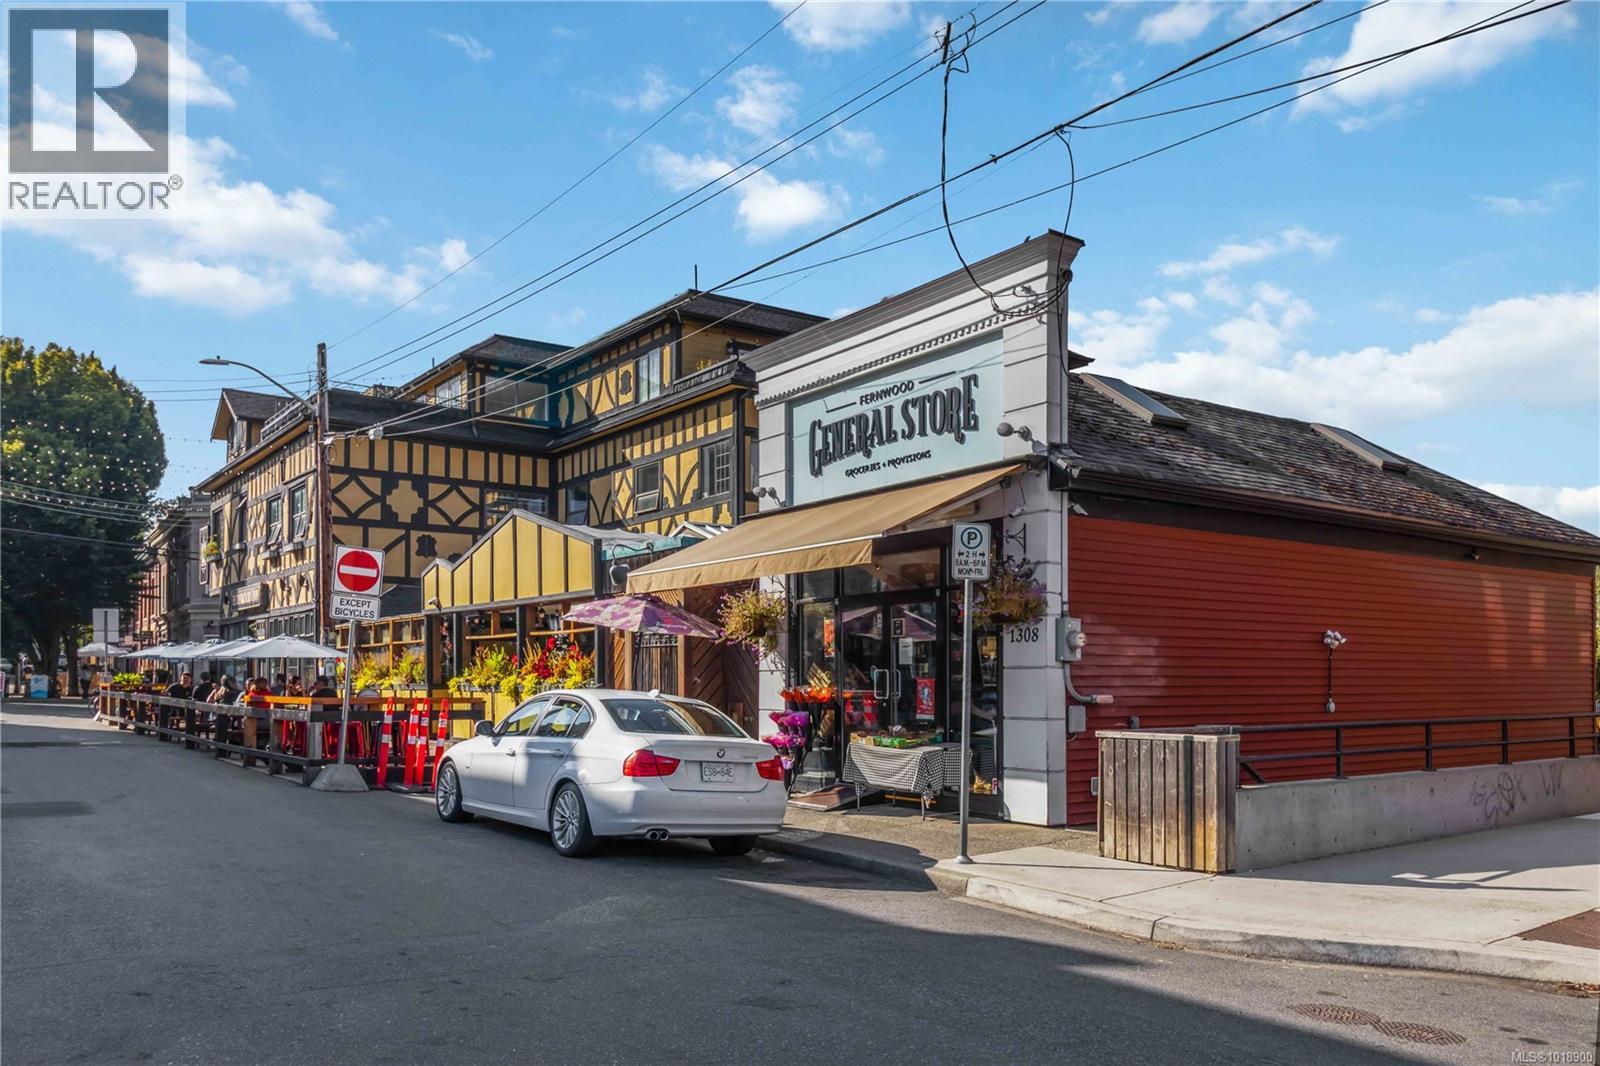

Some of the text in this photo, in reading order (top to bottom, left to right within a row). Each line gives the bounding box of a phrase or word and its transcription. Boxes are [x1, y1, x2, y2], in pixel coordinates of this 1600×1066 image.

[859, 380, 915, 406] FERNWOOD
[809, 373, 979, 478] GENERAL STORE
[845, 449, 932, 479] GROCERIES PROVISIONS
[967, 531, 978, 545] P
[340, 598, 371, 608] EXCEPT
[335, 607, 375, 618] BICYCLES
[1010, 627, 1039, 643] 1308
